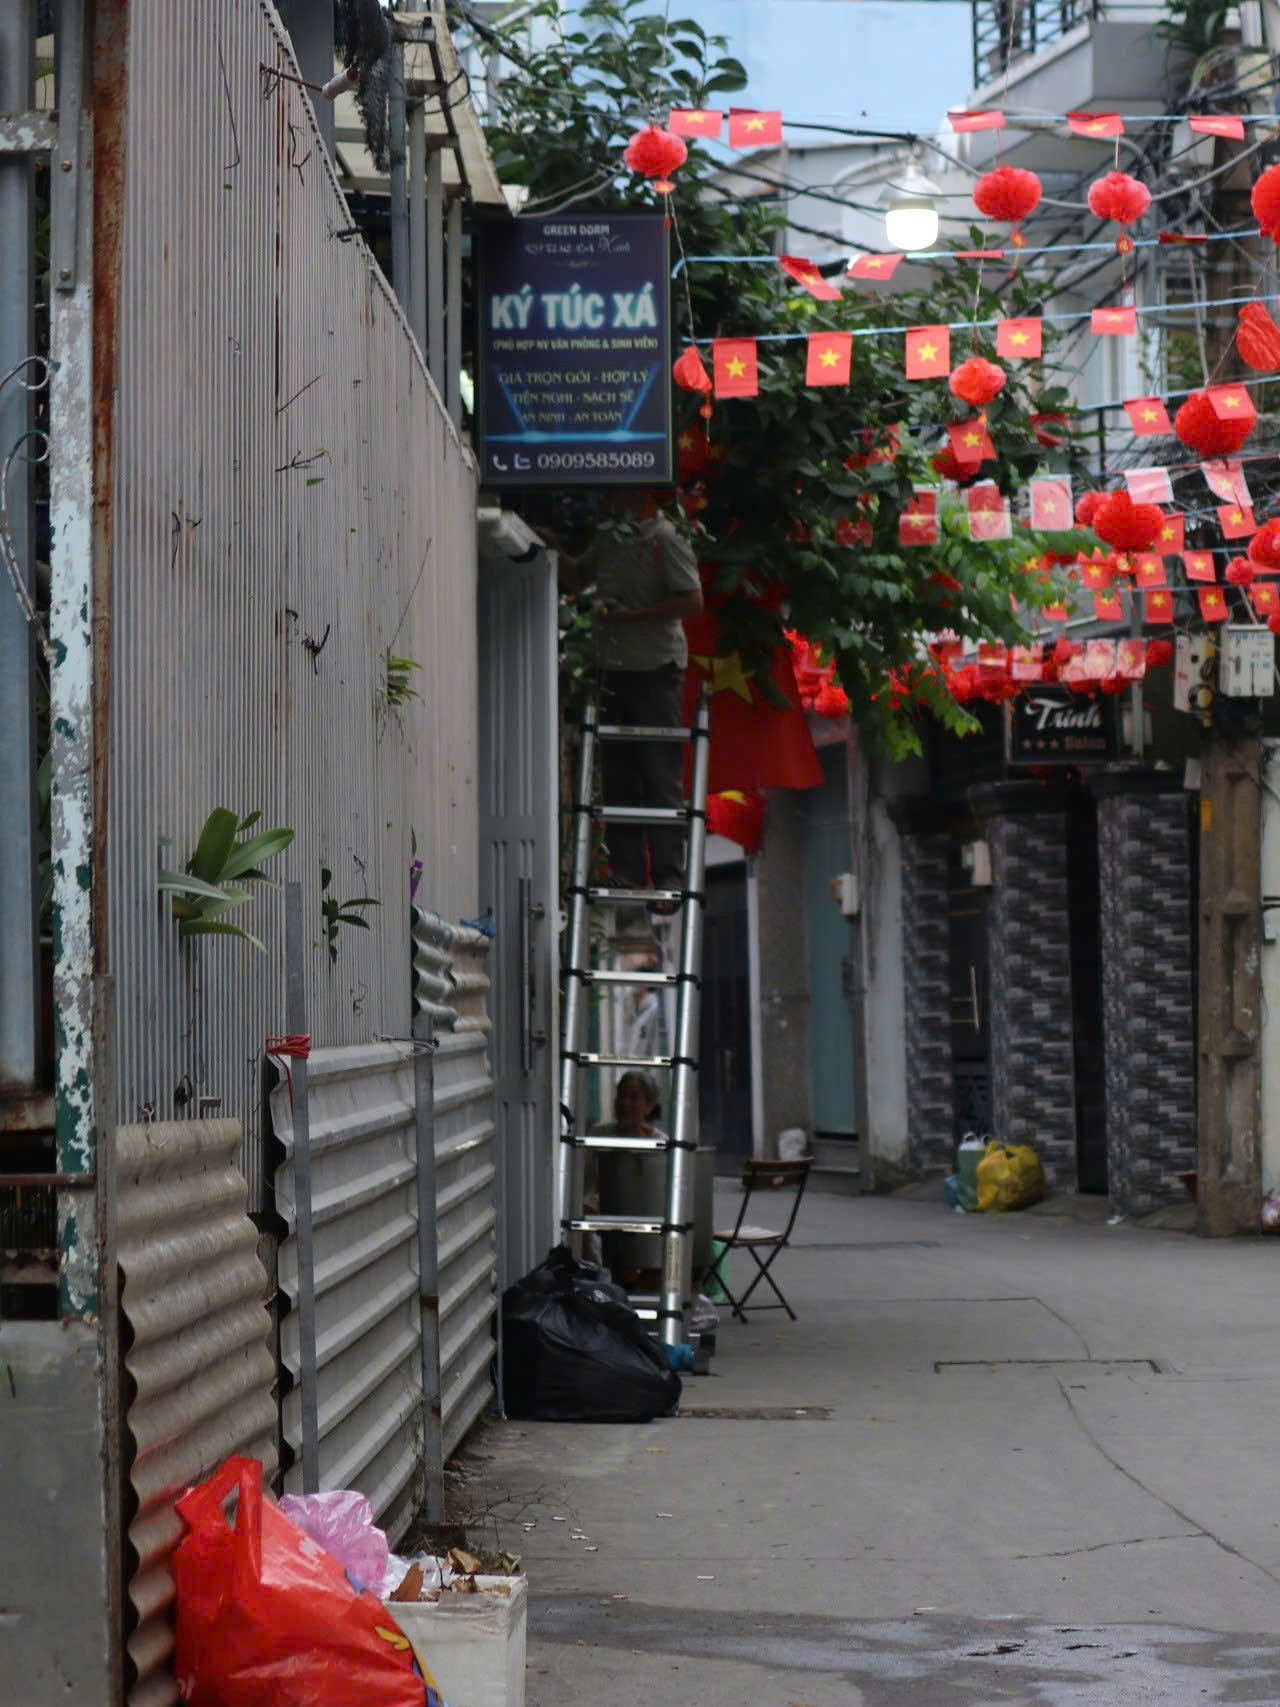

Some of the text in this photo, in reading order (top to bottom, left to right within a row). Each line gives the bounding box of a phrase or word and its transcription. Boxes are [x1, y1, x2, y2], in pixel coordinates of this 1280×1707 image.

[543, 223, 610, 236] GREEN DORM
[491, 281, 657, 329] KÝ TÚC XÁ
[602, 339, 610, 349] &
[610, 338, 632, 349] SINH
[537, 453, 655, 470] 0909585089
